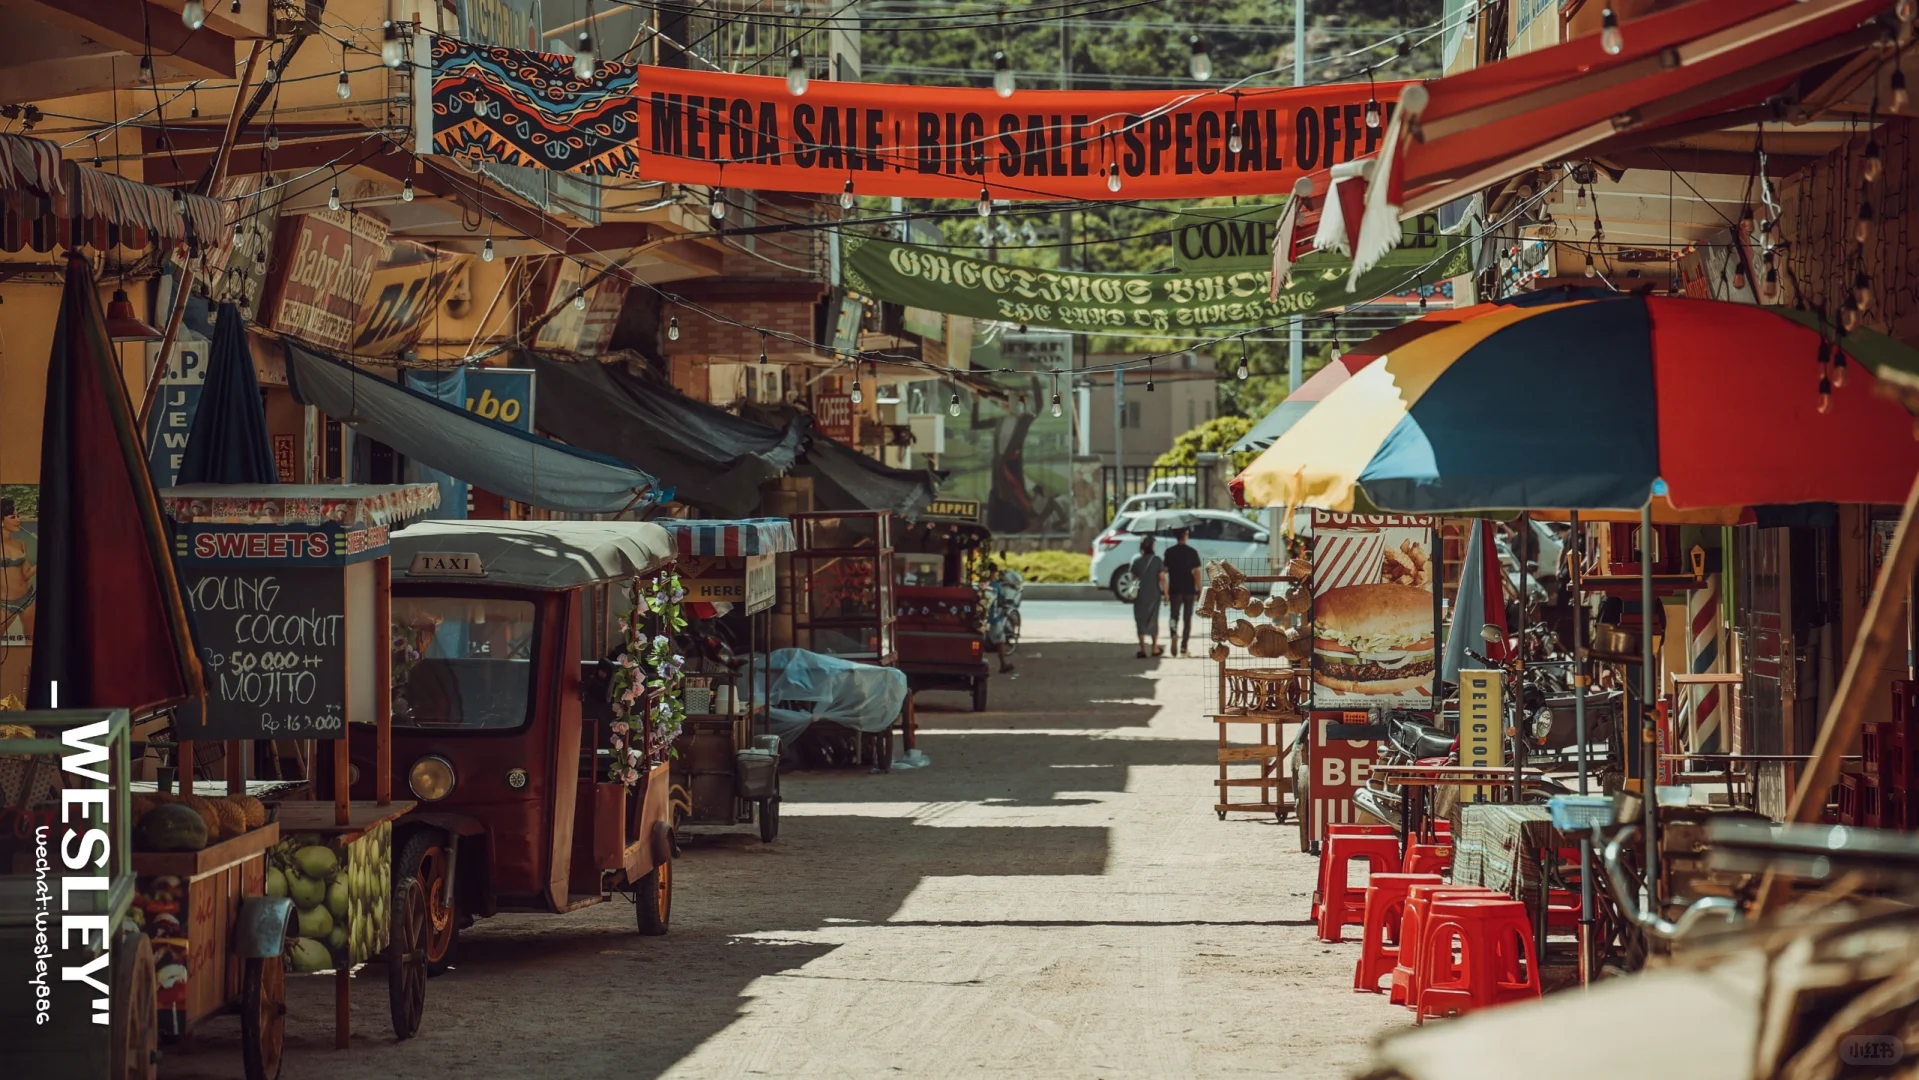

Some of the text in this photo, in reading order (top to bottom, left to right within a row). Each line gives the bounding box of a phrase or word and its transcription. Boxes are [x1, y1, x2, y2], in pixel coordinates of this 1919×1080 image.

[651, 91, 781, 165] MEFGA
[917, 112, 984, 175] BIG
[1123, 109, 1282, 177] SPECIAL
[290, 229, 339, 306] Baby
[329, 244, 373, 304] Ruth
[889, 247, 1153, 304] GREETINGS
[998, 298, 1052, 322] THE
[1059, 307, 1127, 327] LAND
[1133, 309, 1172, 331] OF
[466, 388, 521, 423] bo
[818, 397, 850, 426] COFFEE
[195, 532, 329, 559] SWEETS
[422, 557, 470, 570] TAXI
[187, 576, 281, 612] YOUNG
[701, 585, 742, 597] HERE
[235, 608, 345, 647] COCONUT
[220, 667, 317, 708] MOJITO
[1322, 757, 1380, 787] BE
